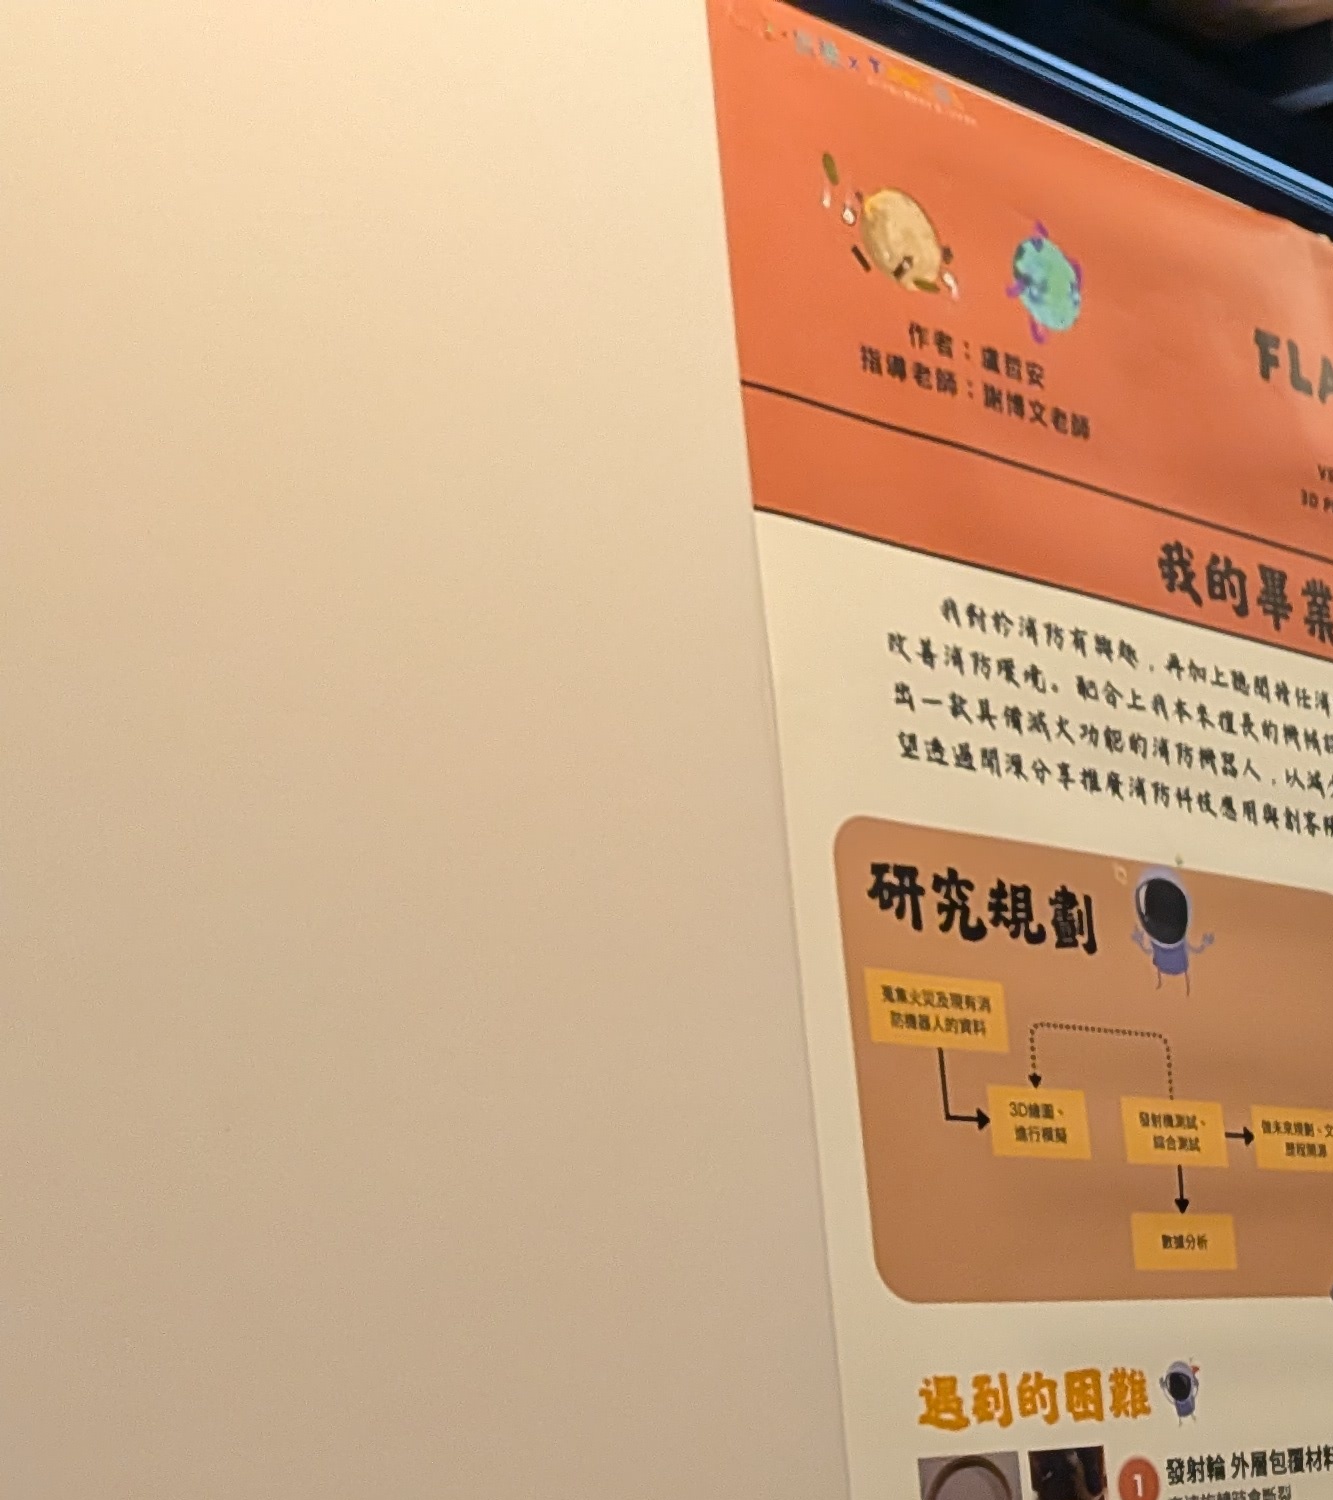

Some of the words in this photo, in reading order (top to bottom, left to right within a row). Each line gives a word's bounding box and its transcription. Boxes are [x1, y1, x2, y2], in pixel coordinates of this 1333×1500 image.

[1301, 488, 1319, 508] 3D
[867, 862, 1098, 955] 研究規劃
[917, 1367, 1152, 1432] 遇到的困難
[1166, 1453, 1226, 1487] 發射輪
